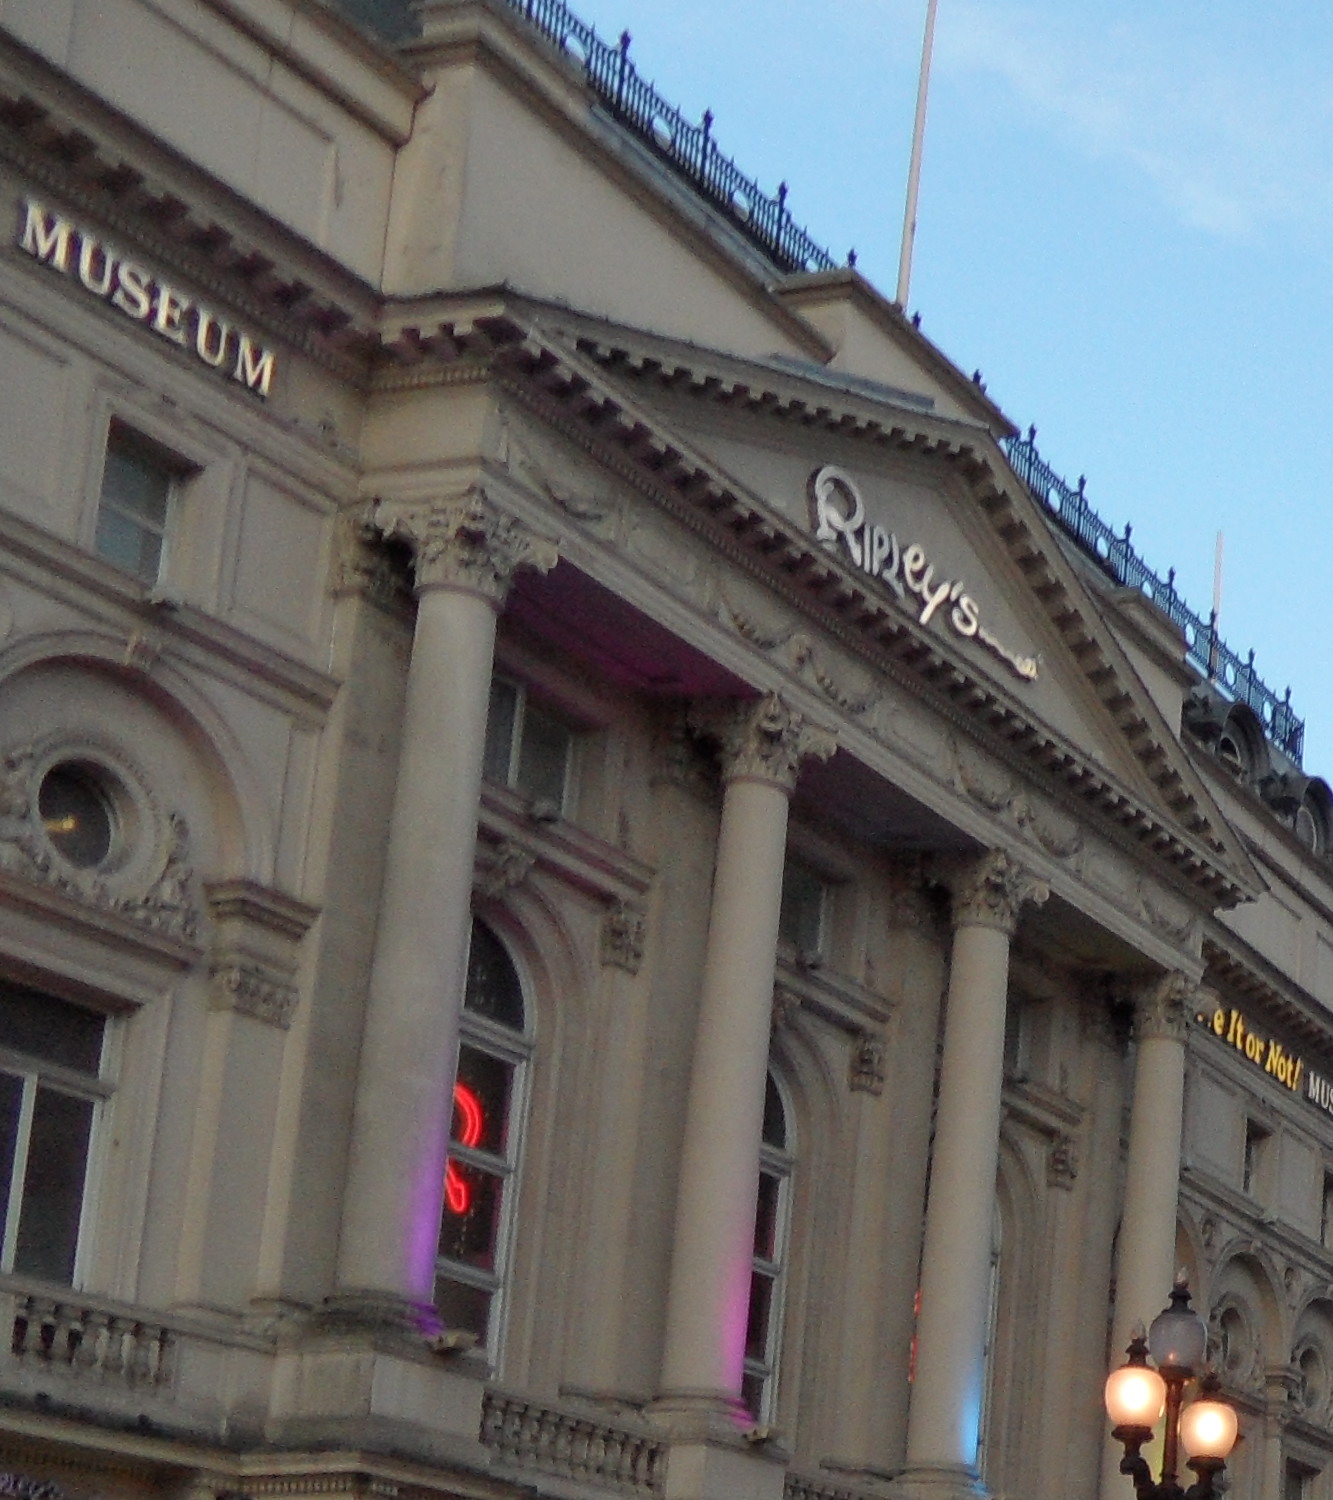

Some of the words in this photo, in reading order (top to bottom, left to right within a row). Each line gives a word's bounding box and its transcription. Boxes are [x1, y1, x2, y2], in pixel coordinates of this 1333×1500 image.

[19, 199, 275, 397] MUSEUM
[1226, 1008, 1245, 1050] It
[1245, 1032, 1265, 1065] or
[1265, 1038, 1304, 1092] Not!
